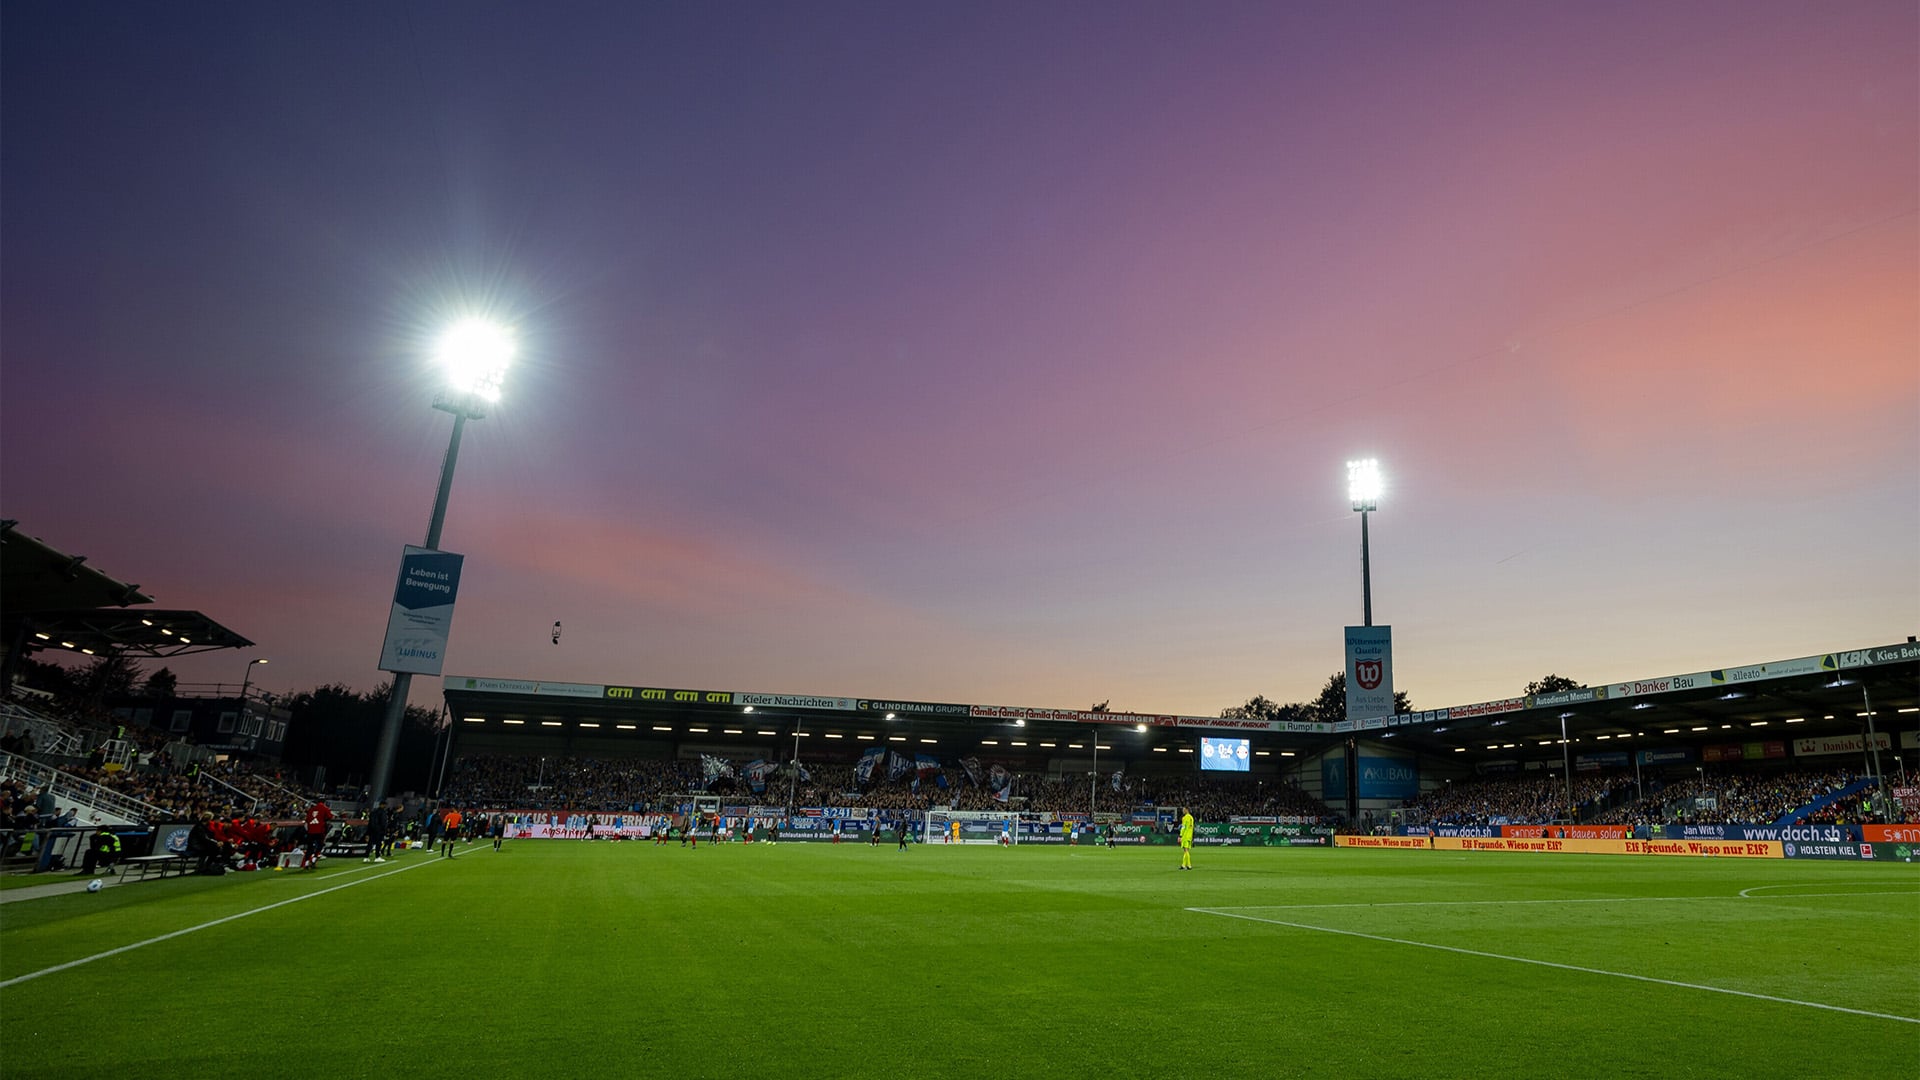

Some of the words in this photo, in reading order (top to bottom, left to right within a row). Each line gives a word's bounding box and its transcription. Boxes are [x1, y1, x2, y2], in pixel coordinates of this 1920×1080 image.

[409, 567, 436, 579] Leben
[437, 571, 449, 581] ist
[405, 578, 450, 594] Bewegung
[399, 648, 437, 660] LUBINUS
[1839, 650, 1873, 669] KBK
[1877, 651, 1899, 661] Kies
[1733, 670, 1760, 681] alleato
[1634, 681, 1670, 694] Danker
[1673, 677, 1694, 689] Bau
[607, 688, 633, 699] CITTI
[641, 689, 666, 700] CITTI
[673, 691, 699, 702] CITTI
[706, 692, 731, 703] CITTI
[1536, 695, 1569, 706] Autodienst
[1569, 691, 1593, 701] Menzel
[742, 695, 773, 705] Kieler
[774, 697, 833, 708] Nachrichten
[872, 702, 934, 713] GLINDEMANN
[935, 704, 968, 714] GRUPPE
[971, 705, 997, 717] famila
[999, 706, 1024, 718] famila
[1025, 708, 1050, 719] famila
[1052, 709, 1077, 720] famila
[1079, 711, 1156, 724] KREUTZBERGER
[1179, 718, 1209, 726] MARKANT
[1287, 722, 1313, 731] Rumpf
[1823, 740, 1855, 751] Danish
[1856, 739, 1887, 750] Cown
[1438, 827, 1492, 838] www.dach.sh
[1554, 828, 1568, 838] wr
[1572, 826, 1596, 839] bauen
[1600, 827, 1622, 838] solar
[1683, 826, 1698, 836] Jan
[1699, 826, 1715, 835] Witt
[1743, 825, 1840, 842] www.dach.sh
[1357, 838, 1382, 846] Freunde.
[1412, 839, 1425, 847] Elf?
[1462, 840, 1472, 849] Elf
[1473, 841, 1505, 849] Freunde.
[1506, 841, 1529, 850] Wieso
[1546, 841, 1562, 850] Elf?
[1625, 842, 1641, 852] Elf
[1641, 842, 1686, 853] Freunde.
[1688, 843, 1721, 854] Wieso
[1723, 847, 1743, 855] nur
[1746, 844, 1769, 855] Elf?
[1800, 846, 1837, 855] HOLSTEIN
[1839, 846, 1857, 856] KIEL
